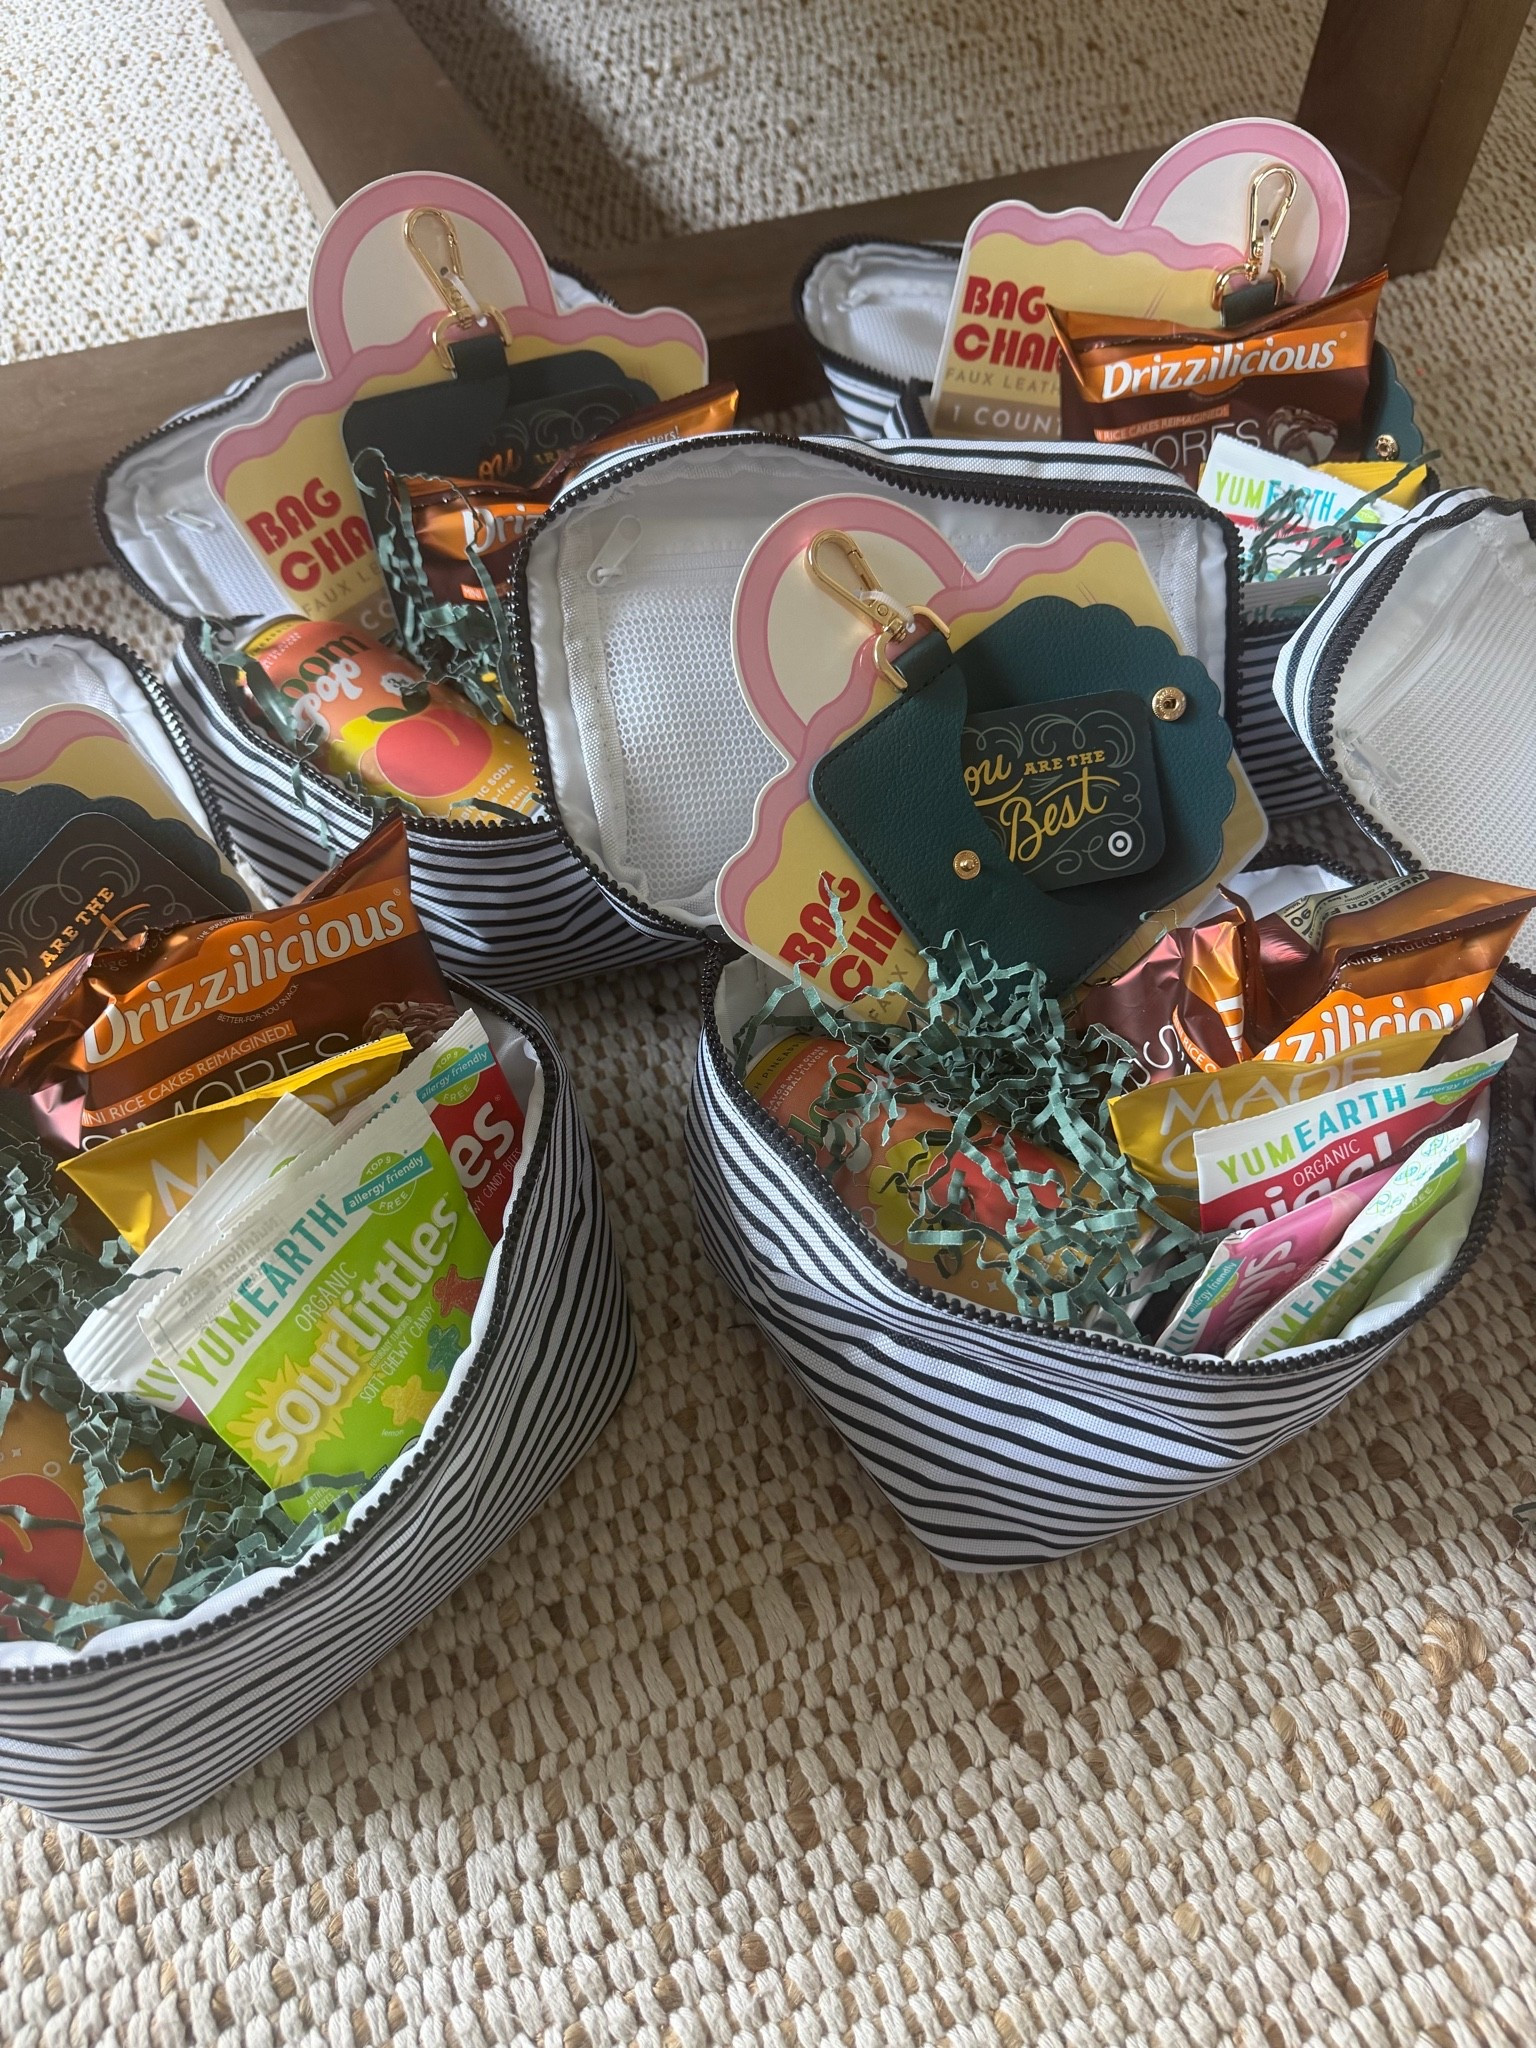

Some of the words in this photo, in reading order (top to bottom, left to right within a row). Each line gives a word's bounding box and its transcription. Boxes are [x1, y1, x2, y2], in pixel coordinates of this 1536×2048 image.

[962, 275, 1046, 325] BAG
[953, 323, 1062, 373] CHA
[1102, 337, 1337, 400] Drizzilicious
[945, 368, 993, 387] FAUX
[1003, 375, 1060, 394] LEATH
[245, 476, 342, 556] BAG
[281, 515, 374, 591] CHA
[1023, 758, 1063, 776] ARE
[1066, 750, 1105, 767] THE
[1000, 767, 1120, 863] Best
[38, 925, 79, 969] ARE
[75, 887, 115, 925] THE
[779, 871, 861, 979] BAG
[830, 892, 903, 1002] CHA
[82, 899, 404, 1064] Drizzilicious
[109, 1095, 146, 1122] RICE
[149, 1070, 195, 1102] CAKES
[197, 1024, 292, 1076] REIMAGINED!
[420, 1072, 450, 1100] allergy
[451, 1050, 488, 1077] friendly
[436, 1053, 454, 1069] TOP
[443, 1083, 472, 1102] FREE
[1217, 1084, 1408, 1185] YUMEARTH
[1293, 1138, 1361, 1187] ORGANIC
[349, 1178, 386, 1208] allergy
[386, 1156, 424, 1185] friendly
[366, 1158, 387, 1176] TOP
[483, 1169, 507, 1199] CANDY
[379, 1192, 409, 1211] FREE
[178, 1201, 348, 1388] YUMEARTH
[294, 1261, 358, 1332] ORGANIC
[1209, 1261, 1237, 1291] friendly
[360, 1374, 385, 1404] SOFT
[380, 1336, 414, 1376] CHEWY
[410, 1302, 435, 1338] CANDY
